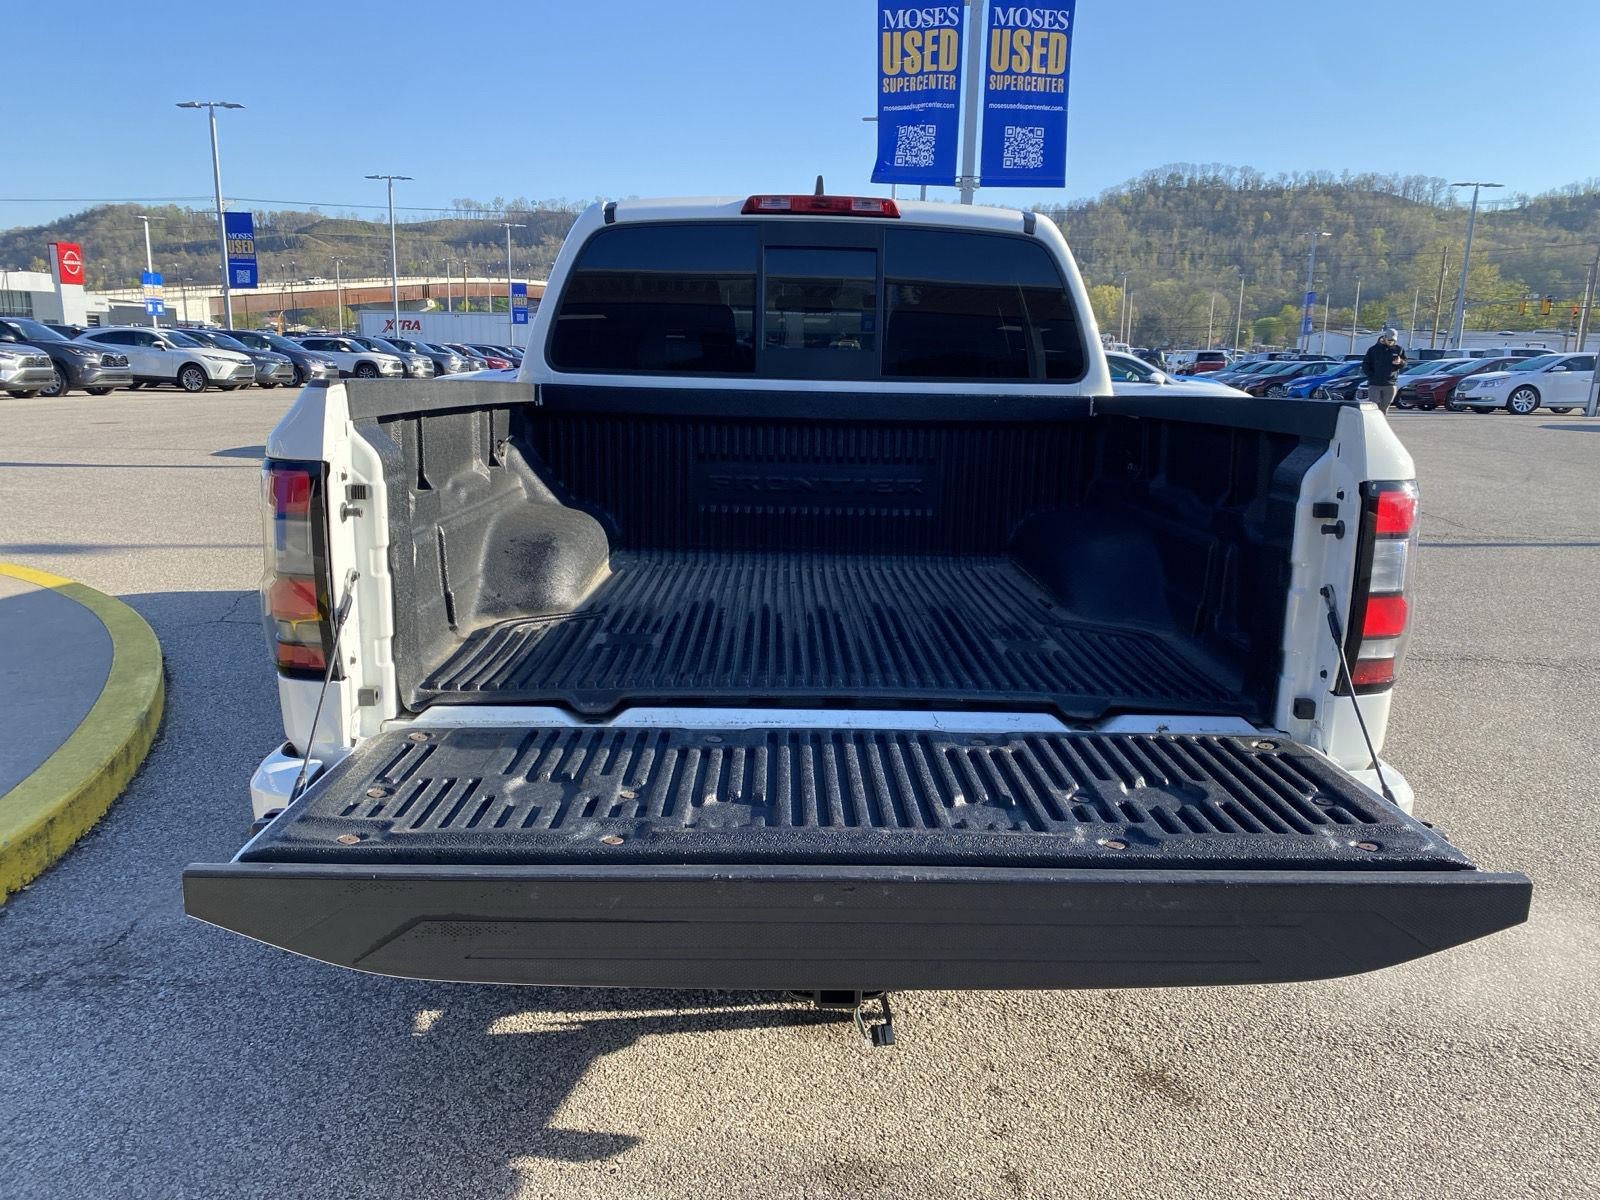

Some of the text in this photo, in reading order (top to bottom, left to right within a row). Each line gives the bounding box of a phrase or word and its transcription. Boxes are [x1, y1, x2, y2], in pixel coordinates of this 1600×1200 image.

[882, 6, 960, 29] MOSES
[993, 7, 1070, 30] MOSES
[882, 29, 959, 75] USED
[990, 29, 1067, 75] USED
[882, 74, 956, 93] SUPERCENTER
[989, 74, 1064, 93] SUPERCENTER
[883, 101, 955, 112] mosesusedsupercenter.com
[988, 102, 1064, 112] mosesusedsupercenter.com
[227, 232, 254, 240] MOSES
[227, 240, 255, 253] USED
